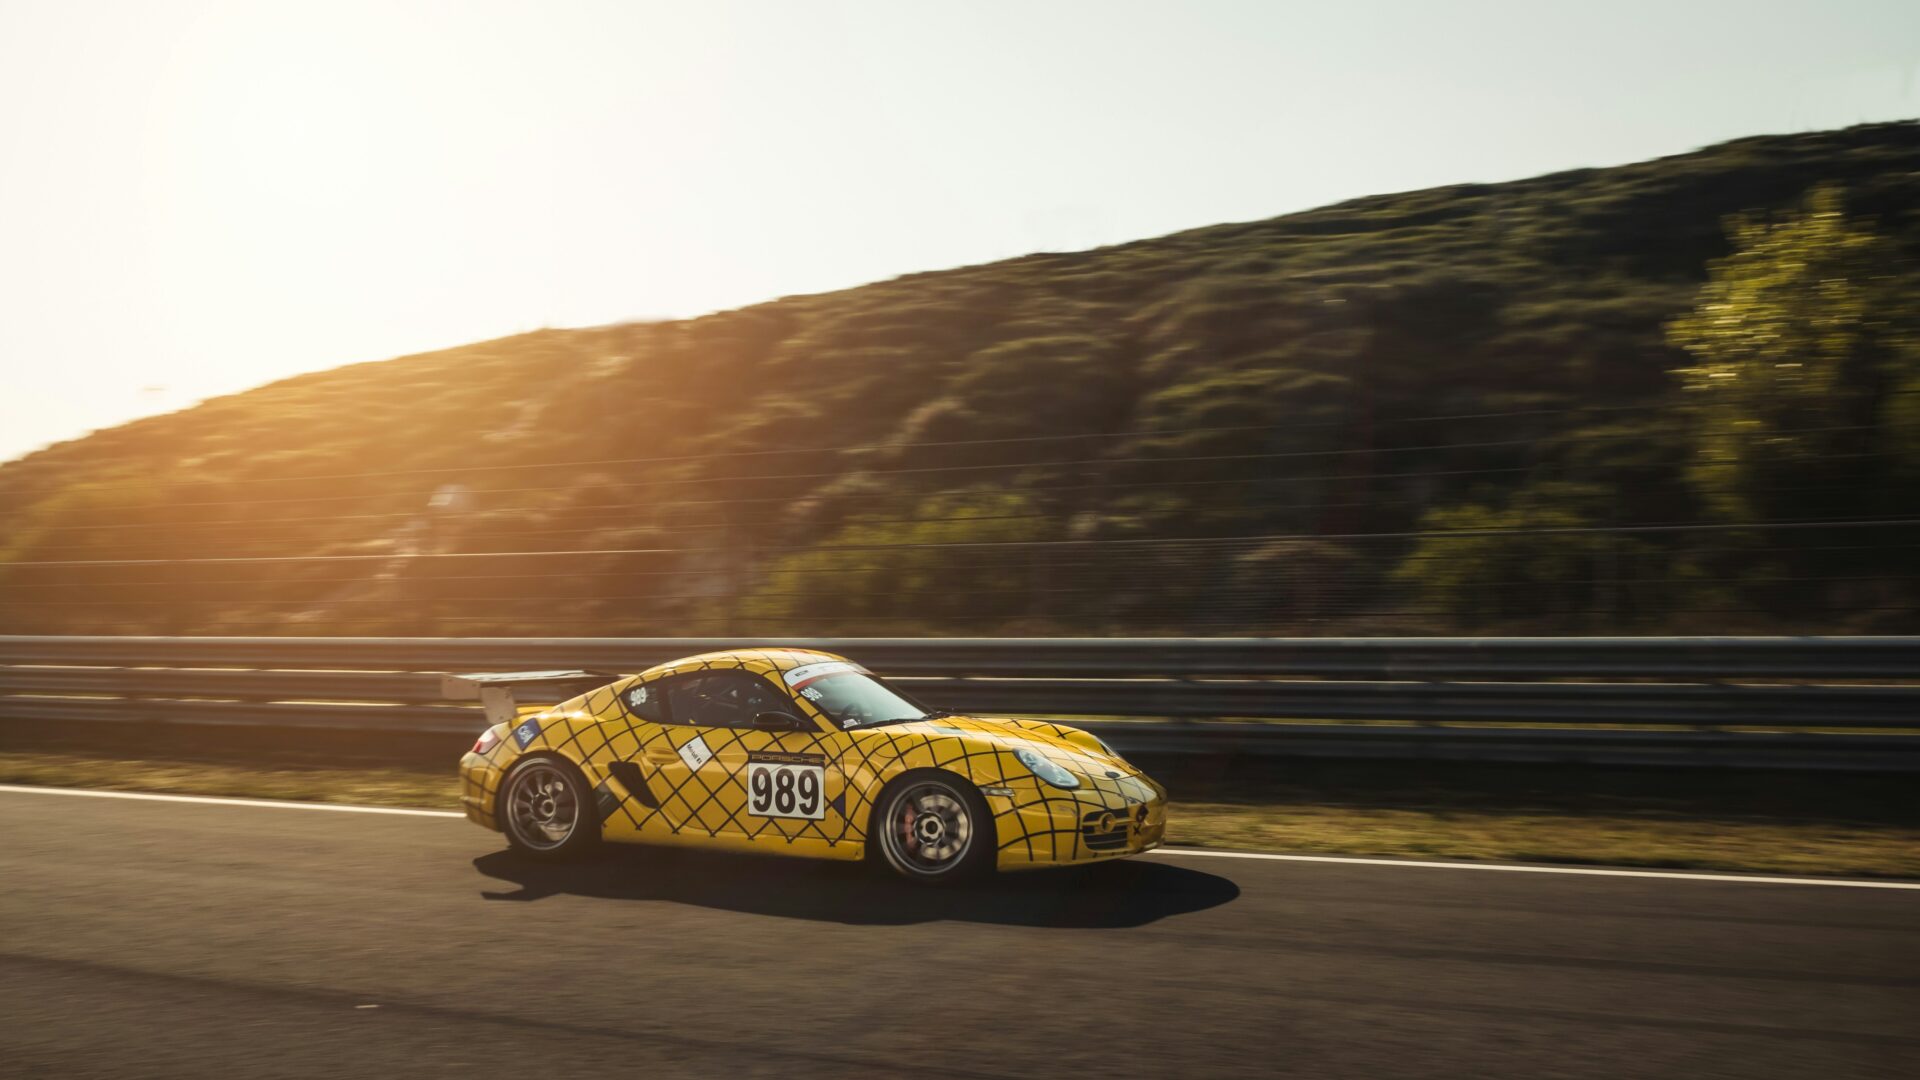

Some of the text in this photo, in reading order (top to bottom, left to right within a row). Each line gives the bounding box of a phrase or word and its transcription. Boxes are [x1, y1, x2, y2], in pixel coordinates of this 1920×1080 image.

[630, 687, 647, 707] 989
[752, 754, 824, 763] PORSCHE
[751, 766, 820, 816] 989
